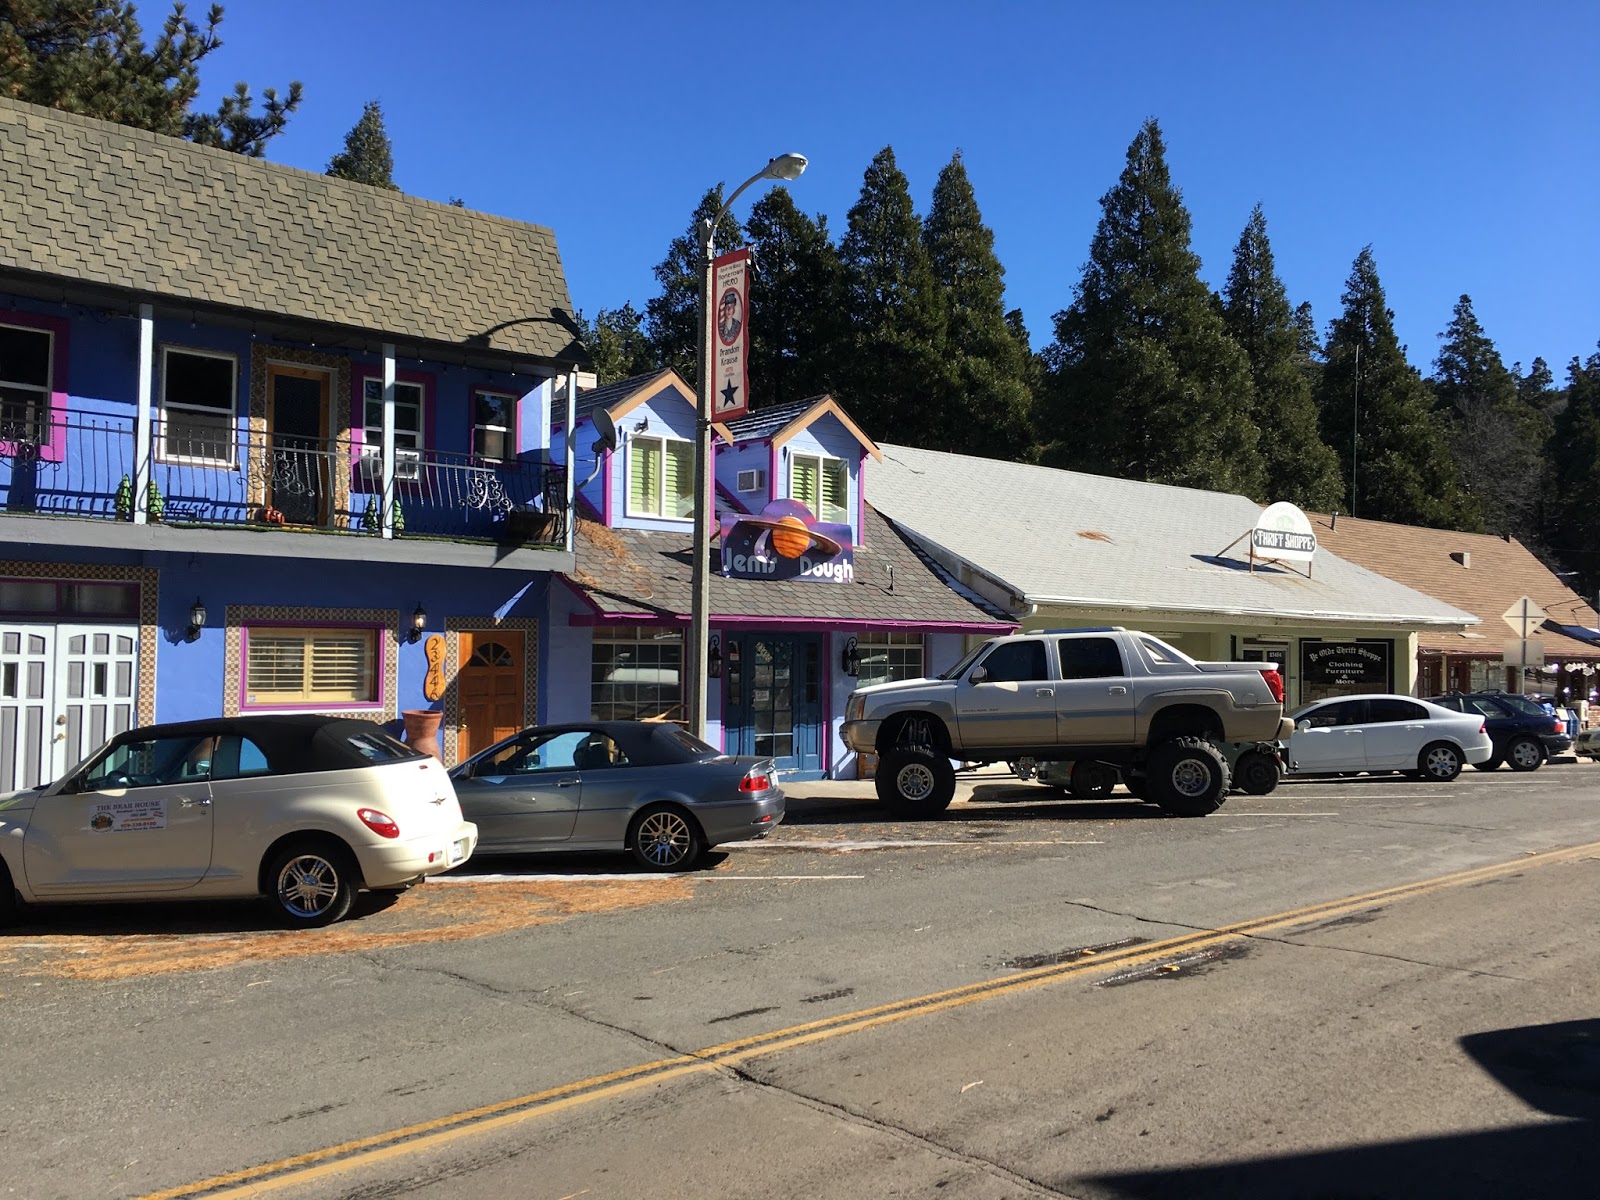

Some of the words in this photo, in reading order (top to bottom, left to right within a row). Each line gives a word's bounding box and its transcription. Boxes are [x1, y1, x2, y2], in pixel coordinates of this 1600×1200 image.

[722, 277, 739, 288] HERO
[1257, 530, 1284, 547] THRIFT
[1285, 533, 1313, 550] SHOPPE
[800, 556, 854, 584] Dough
[1319, 648, 1335, 657] Olde
[1336, 646, 1356, 655] Thrift
[1358, 647, 1382, 661] Shoppe
